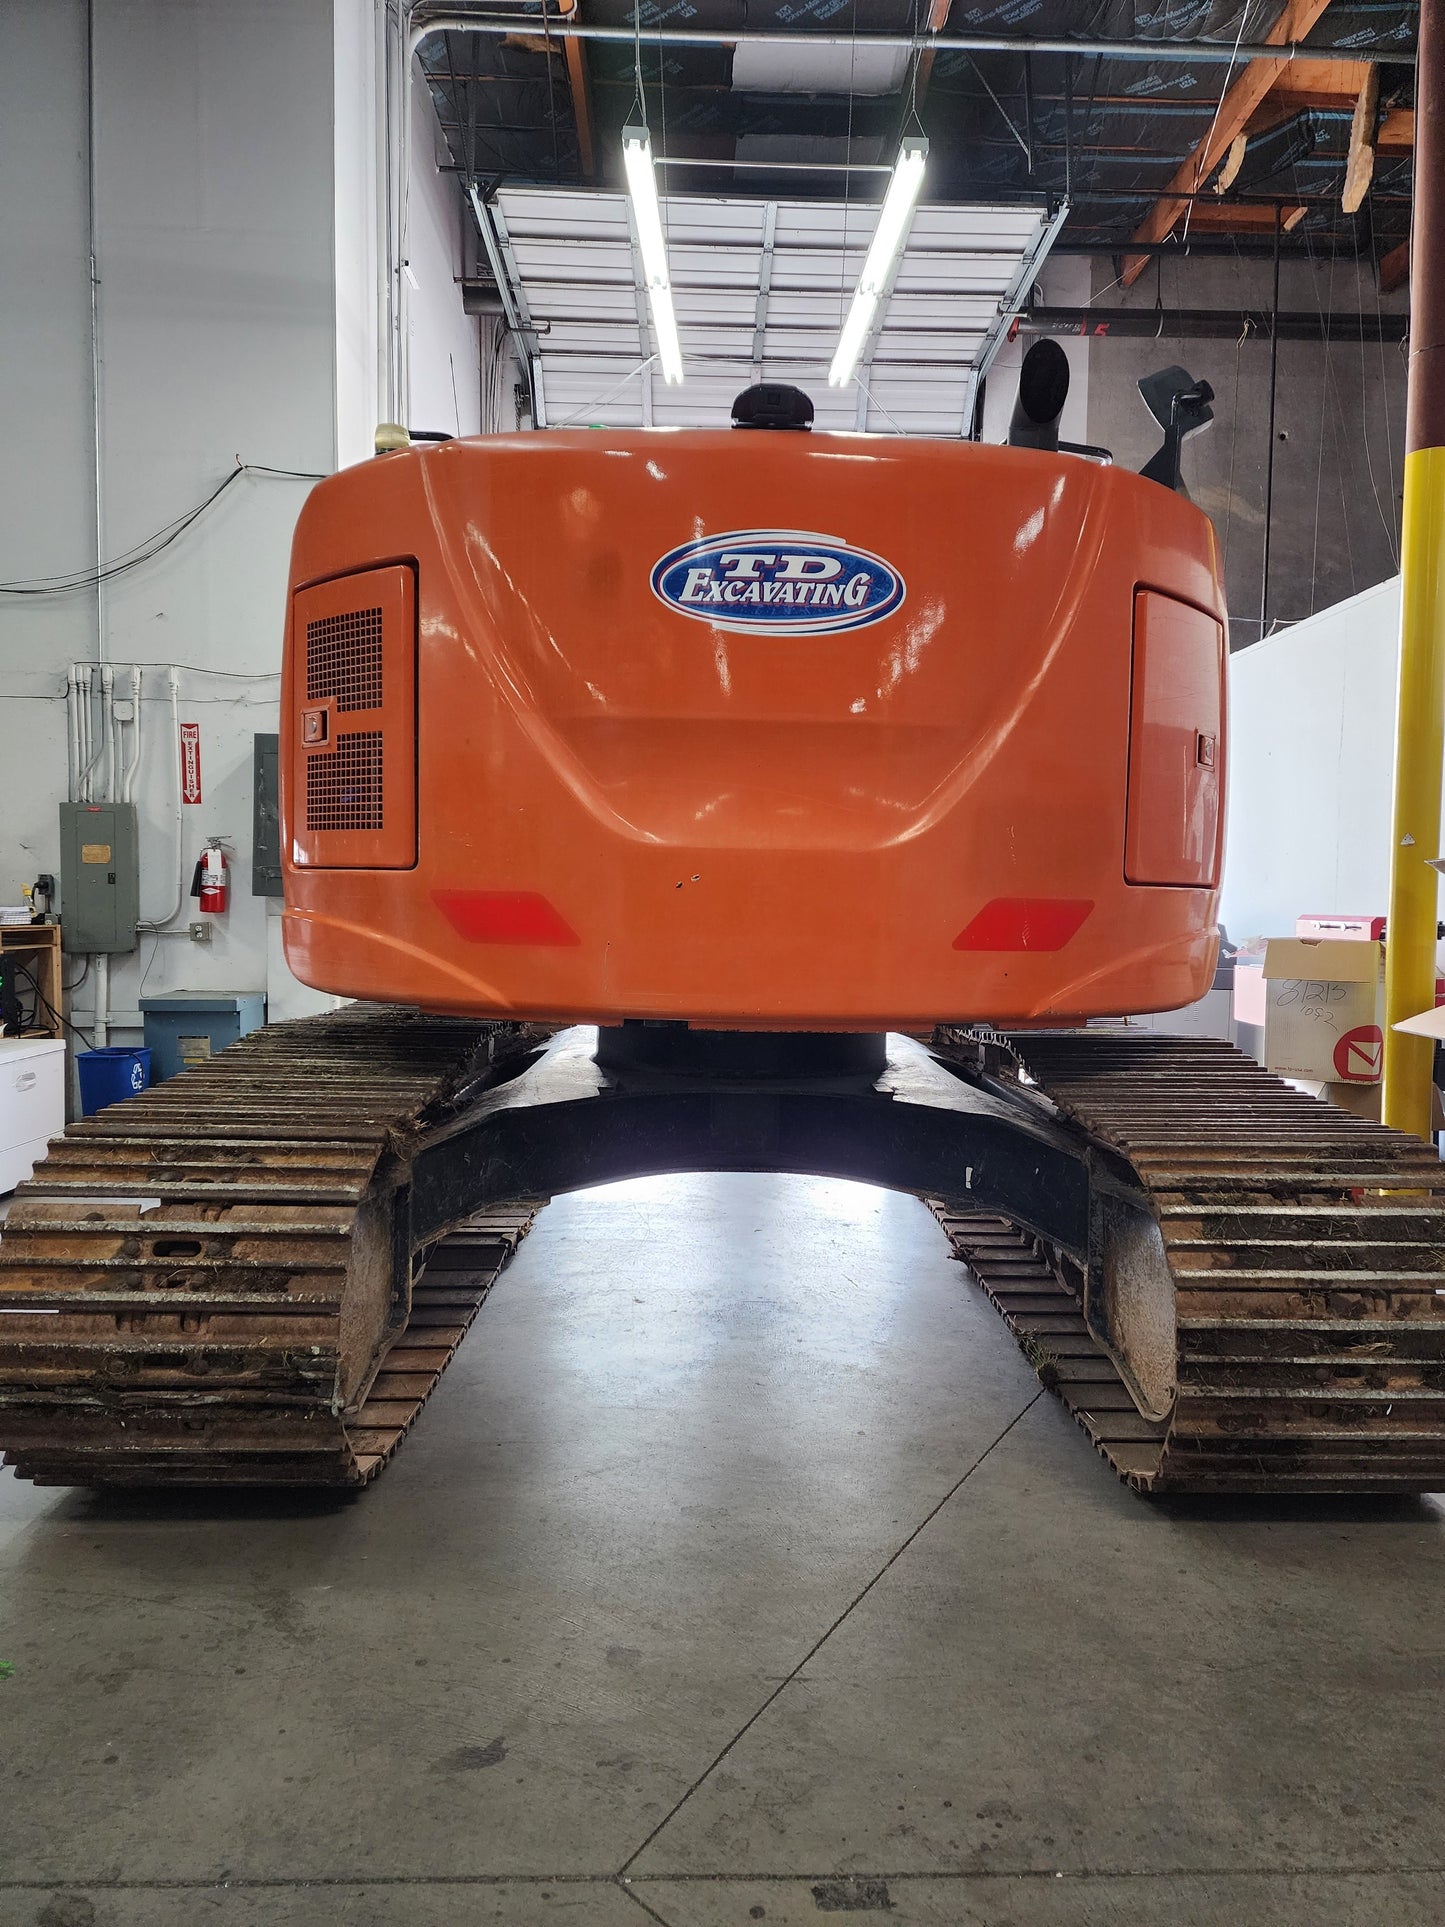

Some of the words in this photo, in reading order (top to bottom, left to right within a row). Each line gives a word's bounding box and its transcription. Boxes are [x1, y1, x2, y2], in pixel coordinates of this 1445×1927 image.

[719, 553, 844, 579] TD
[678, 567, 872, 607] EXCAVATING
[182, 730, 197, 739] FIRE
[187, 741, 195, 797] EXTINGUISHER
